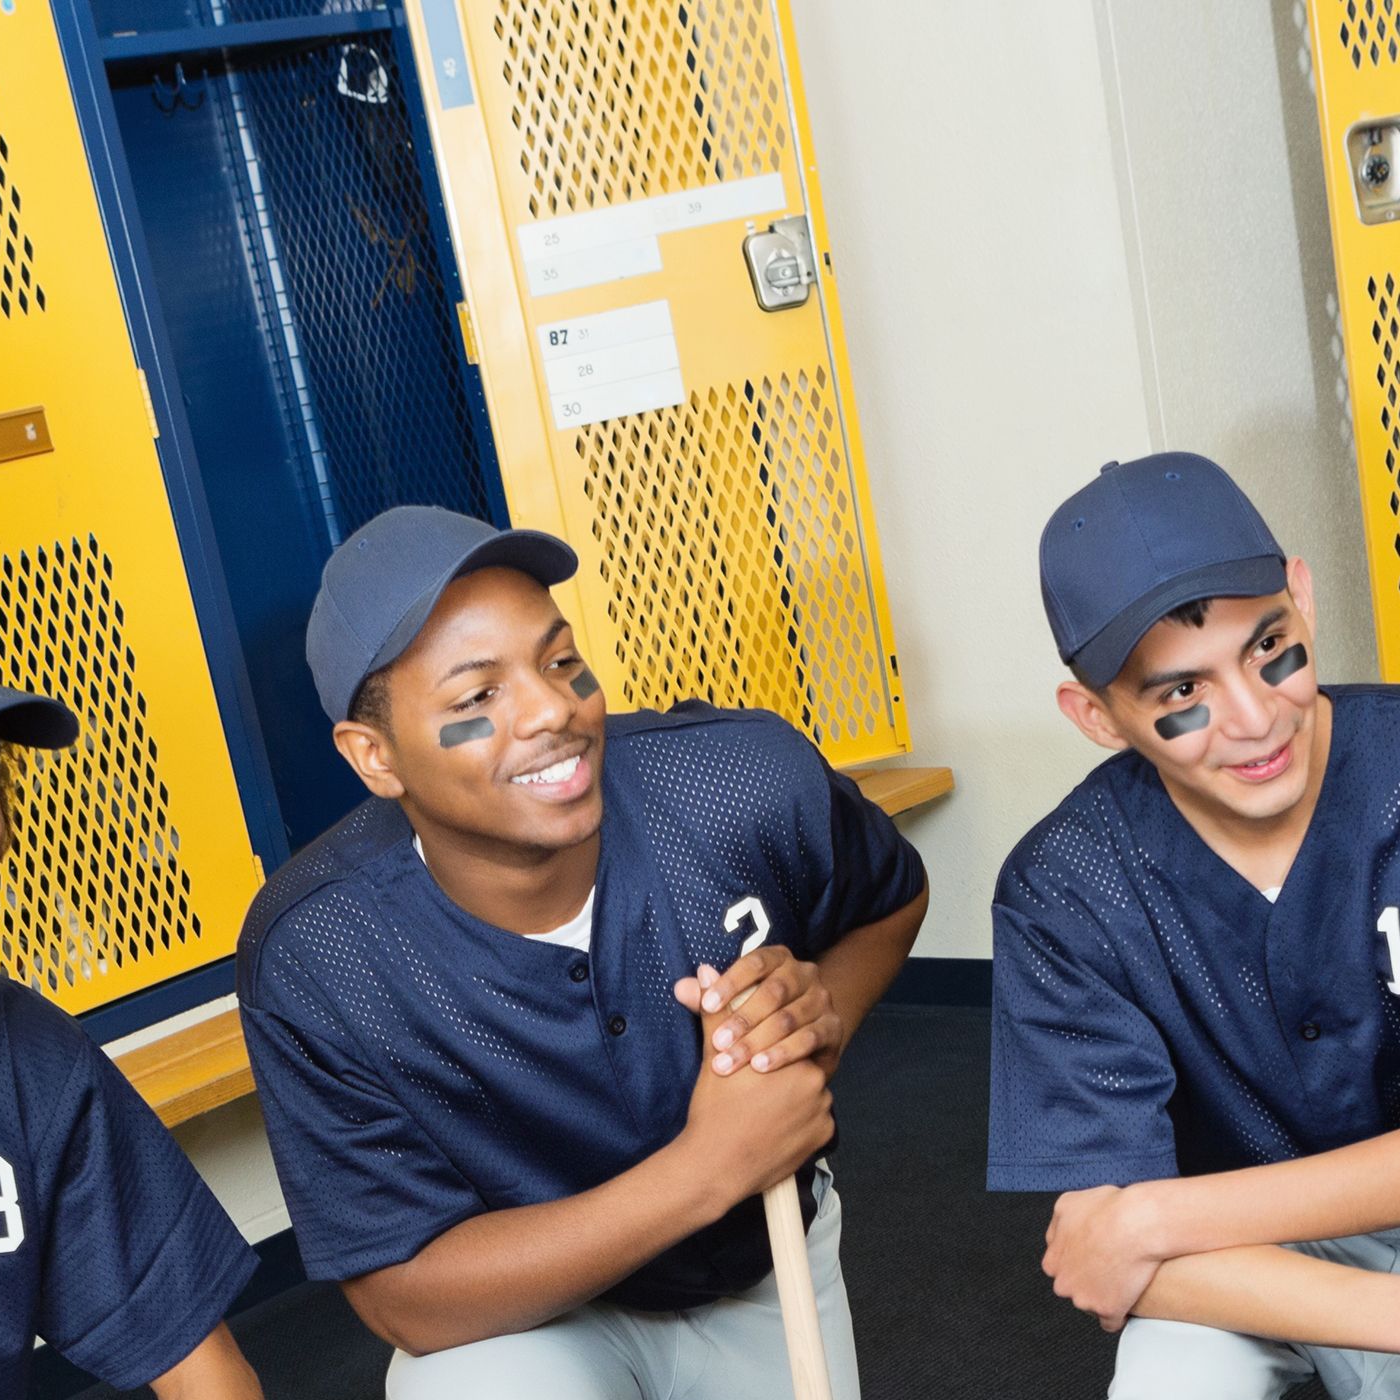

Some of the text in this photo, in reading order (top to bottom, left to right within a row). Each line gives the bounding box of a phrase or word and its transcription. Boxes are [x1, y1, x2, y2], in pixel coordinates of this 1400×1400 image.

[543, 231, 561, 247] 25
[542, 268, 560, 282] 35
[549, 329, 568, 346] 87
[578, 363, 594, 378] 28
[562, 402, 582, 417] 30
